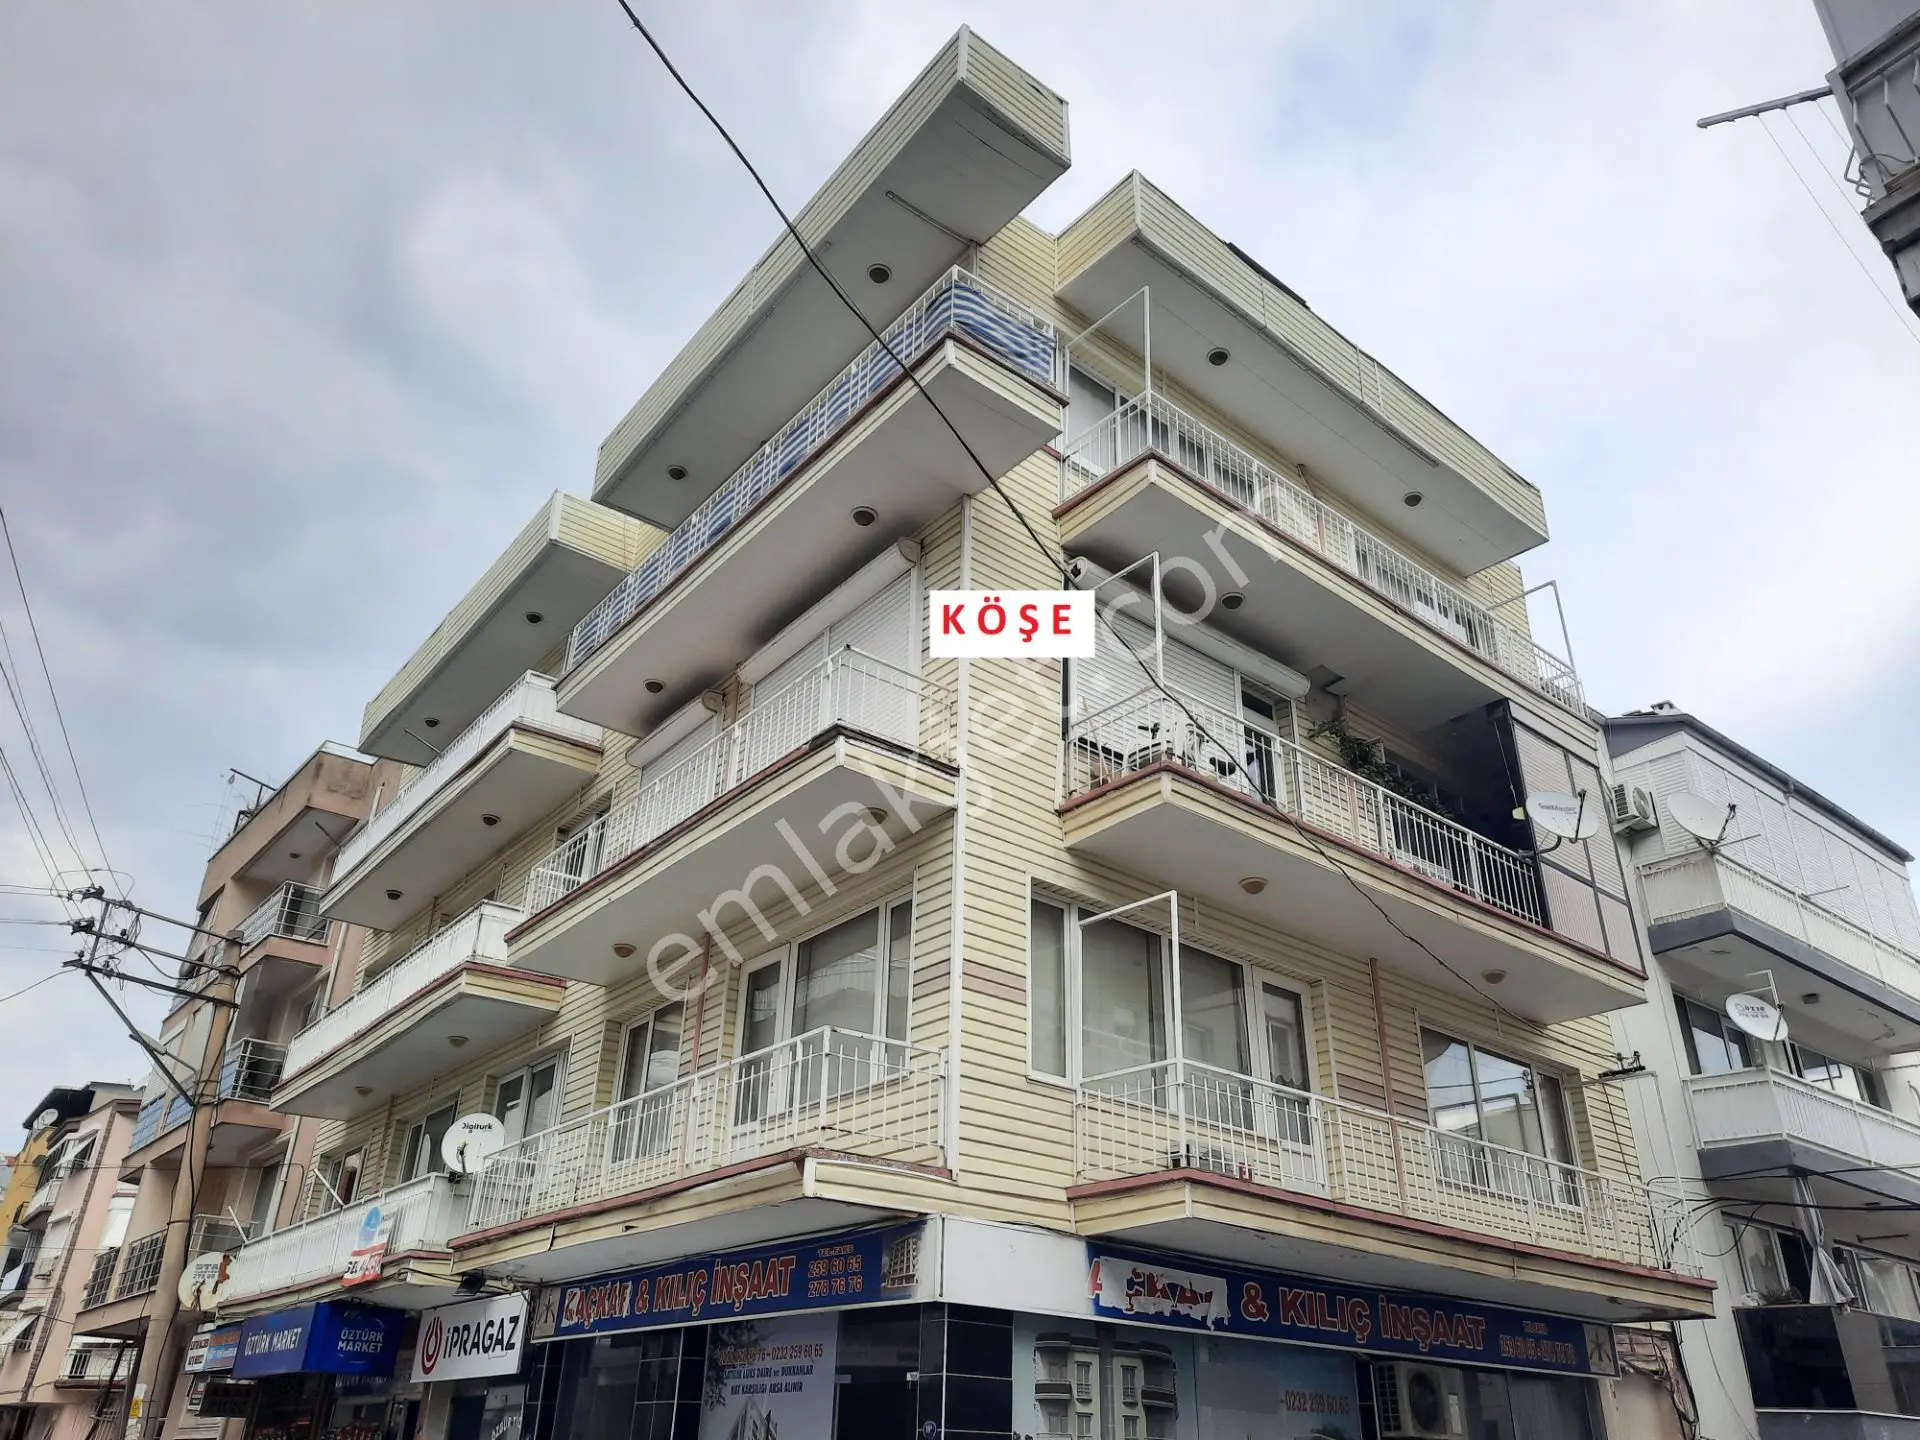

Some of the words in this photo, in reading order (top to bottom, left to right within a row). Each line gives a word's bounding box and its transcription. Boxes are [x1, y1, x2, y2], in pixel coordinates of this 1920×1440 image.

[808, 1259, 829, 1277] 259
[831, 1257, 845, 1275] 60
[847, 1255, 862, 1272] 65
[635, 1279, 649, 1314] &
[653, 1270, 707, 1317] KILIÇ
[710, 1255, 796, 1313] İNŞAAT
[808, 1280, 829, 1297] 278
[831, 1277, 845, 1295] 76
[848, 1275, 863, 1293] 76
[1241, 1282, 1269, 1322] &
[1279, 1287, 1371, 1343] KILIÇ
[1379, 1295, 1486, 1351] İNŞAAT
[244, 1330, 270, 1356] ÖZTÜRK
[271, 1328, 302, 1352] MARKET
[340, 1328, 384, 1342] ÖZTÜRK
[337, 1340, 383, 1353] MARKET
[814, 1343, 824, 1358] 65
